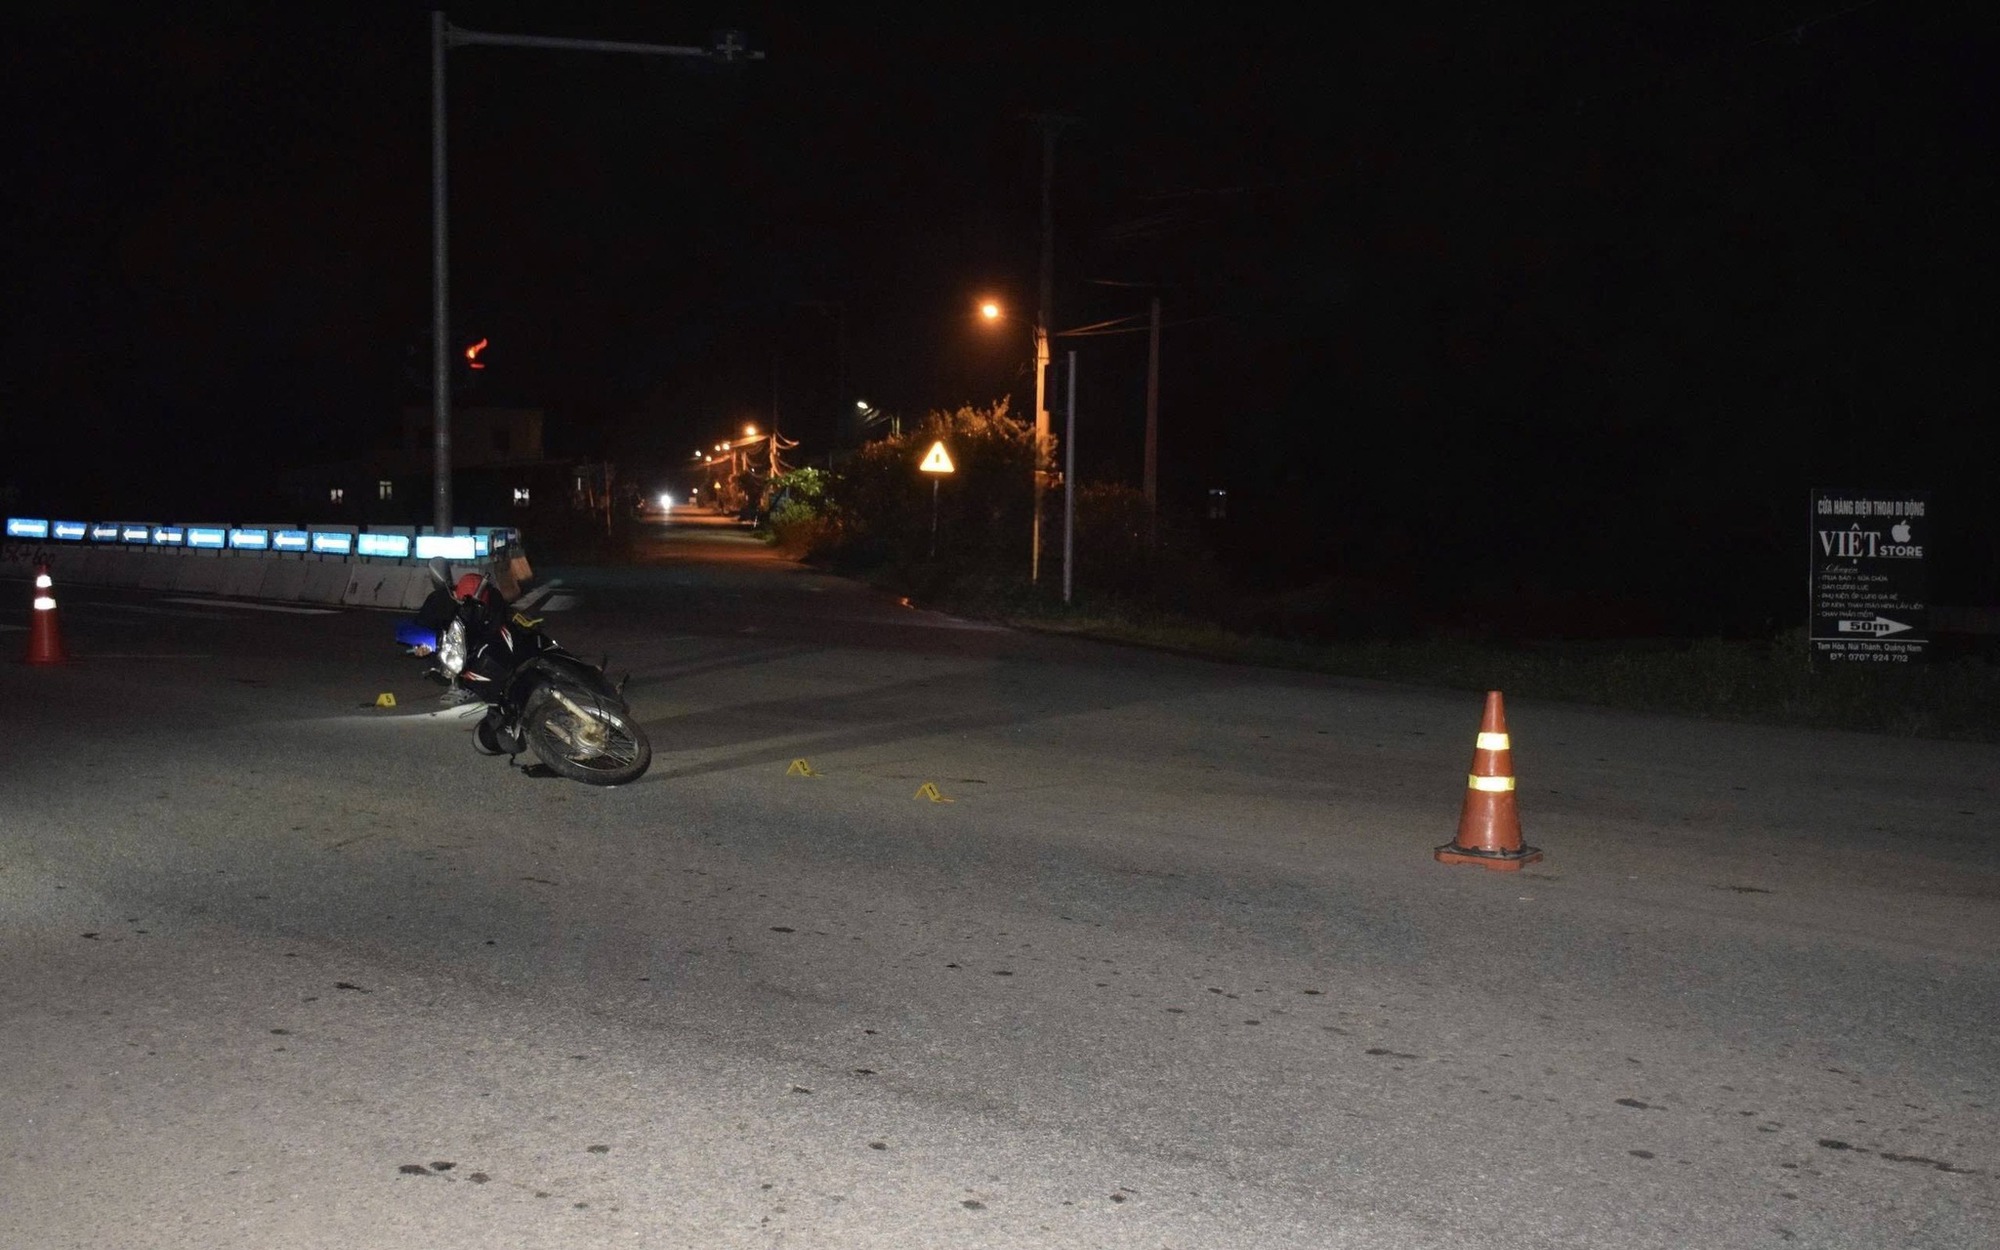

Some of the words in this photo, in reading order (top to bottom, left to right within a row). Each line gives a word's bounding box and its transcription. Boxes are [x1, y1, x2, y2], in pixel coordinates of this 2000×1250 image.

[1834, 497, 1853, 515] HÀNG
[1855, 498, 1872, 518] ĐIỆN
[1873, 500, 1894, 519] THOẠI
[1895, 501, 1903, 516] DI
[1904, 498, 1925, 519] ĐỘNG
[1818, 522, 1881, 564] VIỆT
[1880, 546, 1923, 557] STORE
[1850, 621, 1890, 632] 50m
[1817, 642, 1831, 651] Tam
[1907, 644, 1922, 653] Nam
